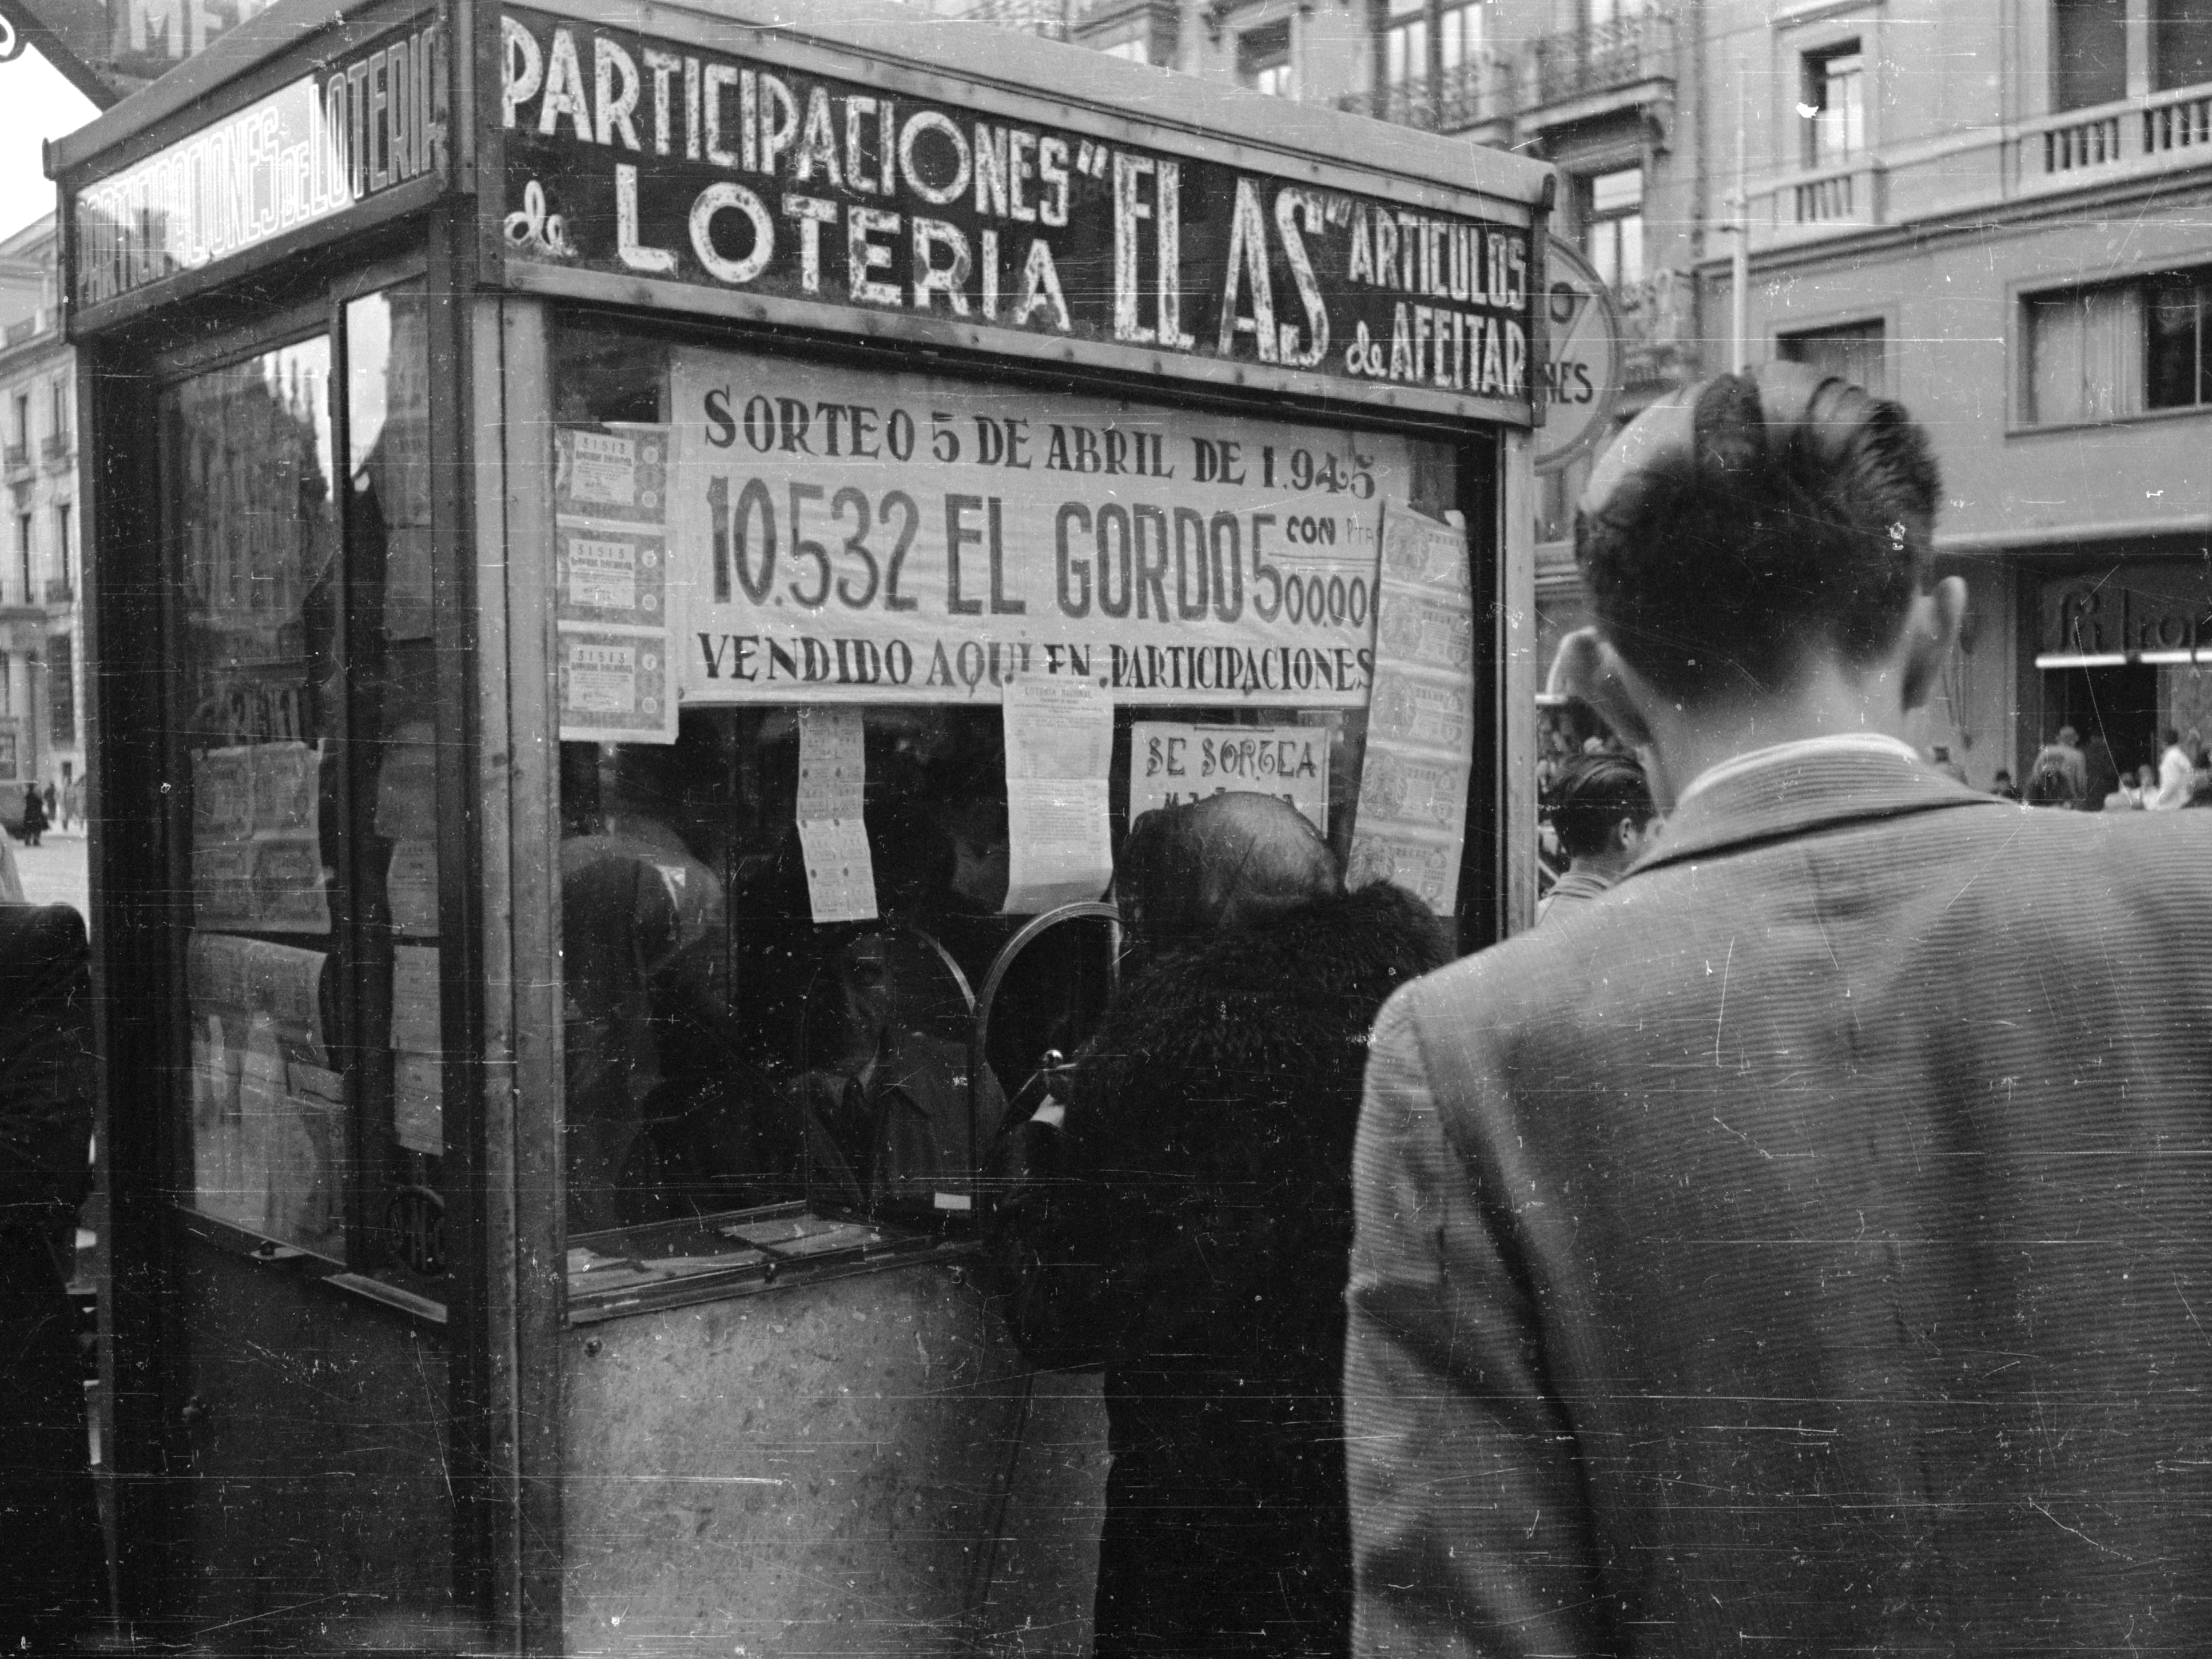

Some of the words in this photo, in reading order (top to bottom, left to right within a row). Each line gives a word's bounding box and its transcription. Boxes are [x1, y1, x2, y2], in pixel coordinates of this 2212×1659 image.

[501, 16, 1068, 226] PARTICIPACIONES
[504, 180, 578, 257] de
[616, 163, 1071, 331] LOTERIA
[1349, 202, 1526, 311] ARTICULOS
[1346, 320, 1388, 377] de
[1390, 301, 1526, 396] AFEITAR
[704, 384, 916, 462] SORTEO
[932, 411, 960, 463] 5
[972, 416, 1032, 470] DE
[1045, 423, 1174, 479] ABRIL
[1191, 436, 1246, 485] DE
[706, 475, 919, 611] 10.532
[945, 493, 1027, 615] EL
[1055, 501, 1244, 623] GORDO
[1287, 515, 1336, 544] CON
[697, 632, 913, 685] VENDIDO
[1109, 643, 1375, 691] PARTICIPACIONES
[1146, 736, 1186, 777] SE
